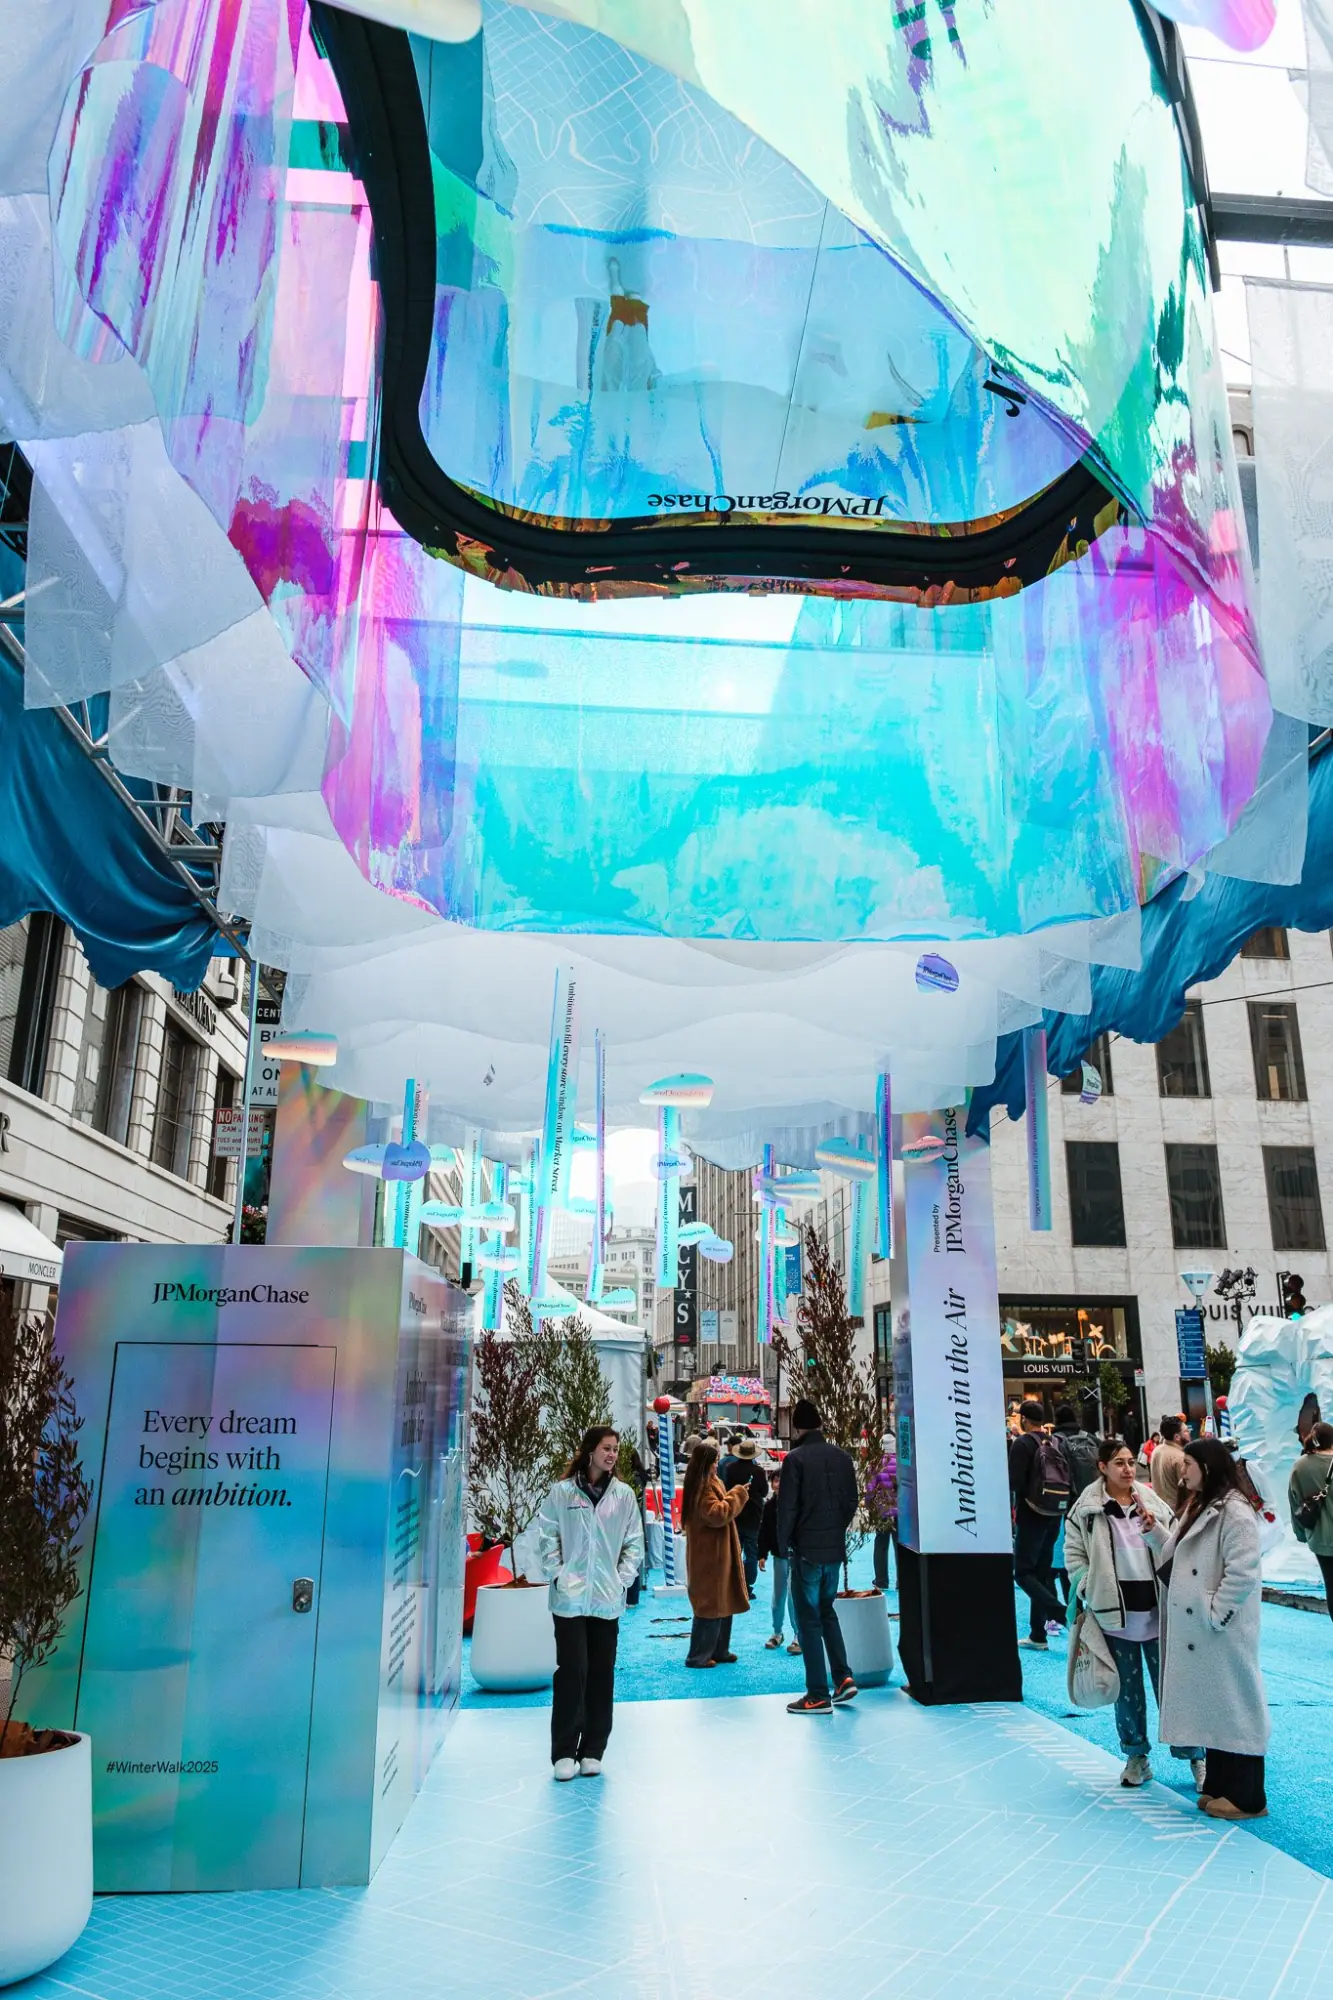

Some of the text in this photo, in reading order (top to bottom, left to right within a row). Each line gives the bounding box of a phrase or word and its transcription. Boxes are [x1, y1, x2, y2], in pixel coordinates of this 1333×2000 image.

[647, 492, 888, 517] JPMorganChase
[566, 980, 577, 1016] Ambition
[560, 1045, 571, 1067] every
[559, 1068, 569, 1088] store
[252, 1087, 263, 1096] AT
[557, 1089, 568, 1121] window
[219, 1111, 264, 1123] NO PAING
[556, 1122, 564, 1133] on
[553, 1134, 564, 1165] Market
[942, 1107, 966, 1254] JPMorganChase
[932, 1204, 940, 1214] by
[28, 1262, 56, 1278] MONCLER
[152, 1282, 310, 1307] JPMorganChase
[1183, 1304, 1242, 1320] OUIS
[1023, 1363, 1090, 1373] LOUIS VUITT
[142, 1409, 297, 1439] Every dream
[943, 1287, 978, 1538] Ambition in the Air
[139, 1445, 281, 1475] begins with
[134, 1482, 292, 1507] an ambition.
[106, 1760, 219, 1775] #WinterWalk2025
